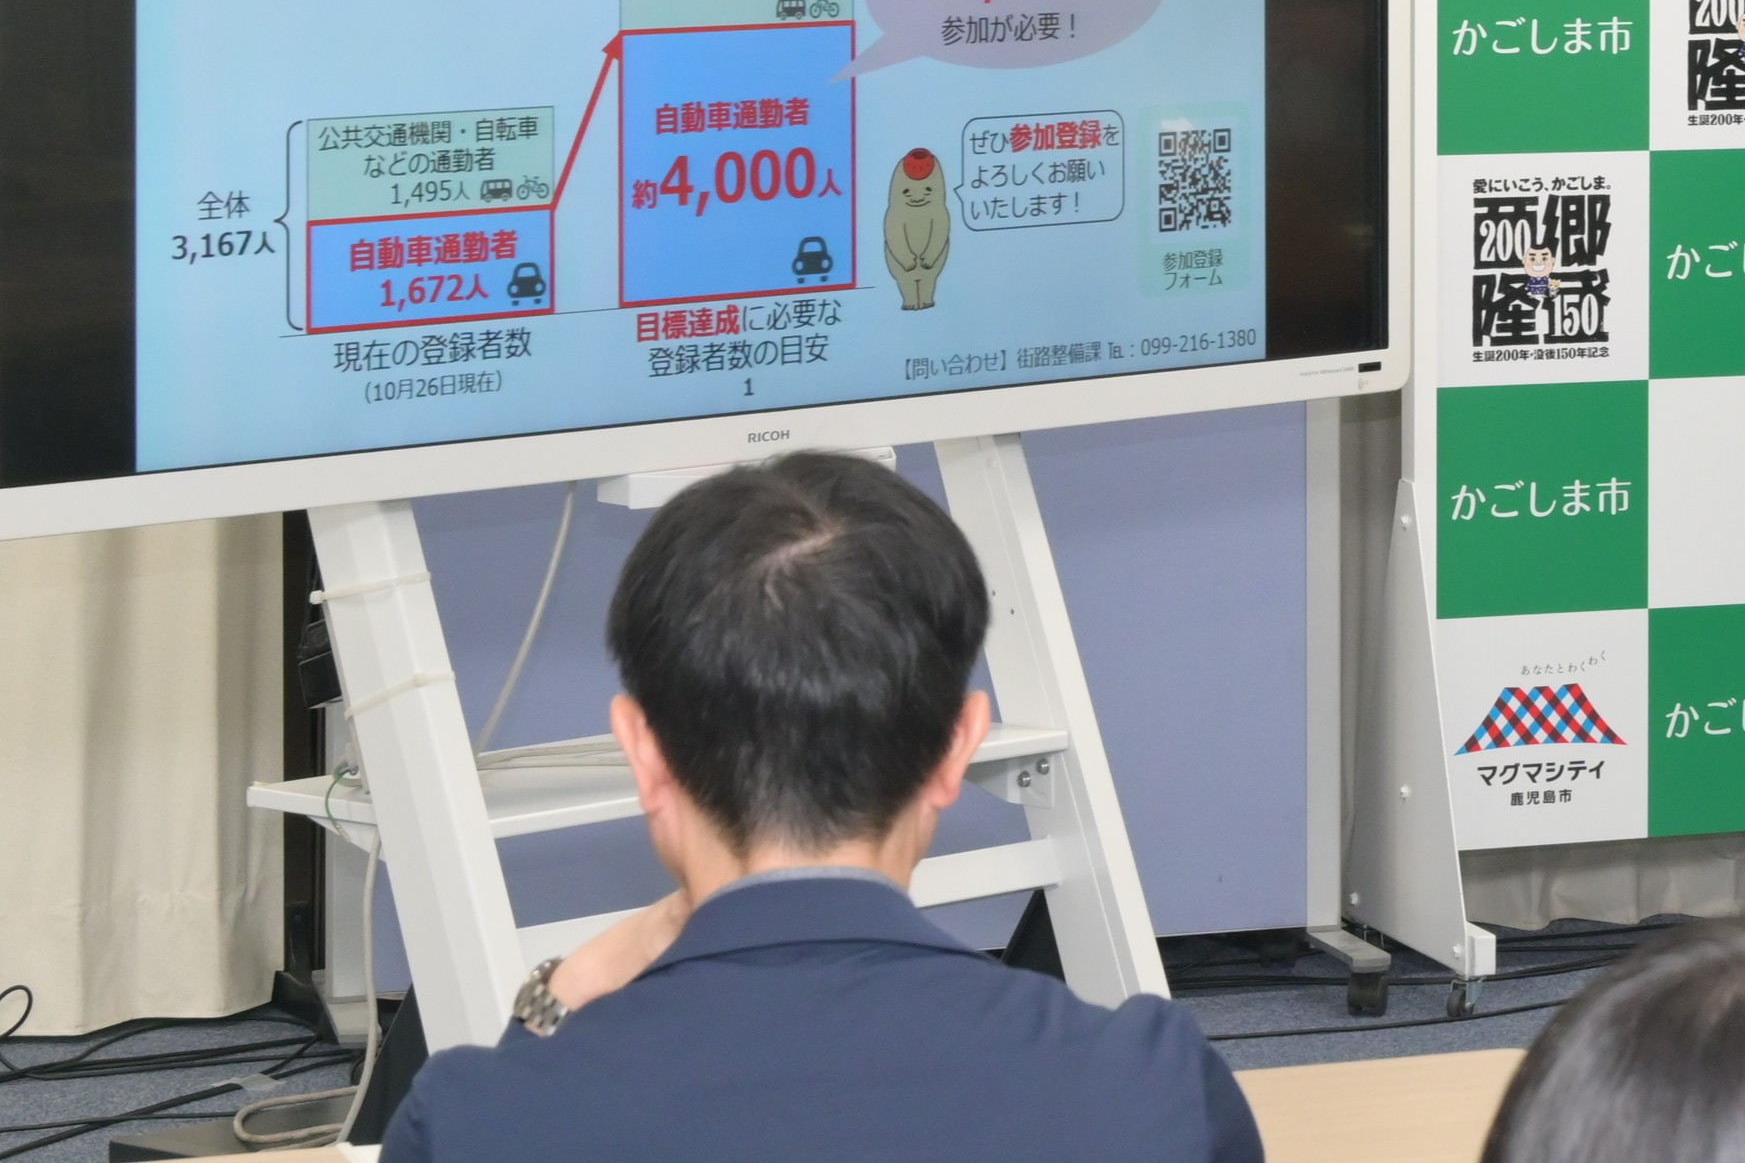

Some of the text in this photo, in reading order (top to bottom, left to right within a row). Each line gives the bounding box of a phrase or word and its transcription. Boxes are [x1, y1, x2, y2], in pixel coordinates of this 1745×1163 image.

[1453, 16, 1633, 56] かごしま市
[657, 98, 810, 134] 自動車通勤者
[970, 121, 1120, 154] ぜひ参加登録を
[363, 148, 496, 179] などの通勤者
[971, 159, 1105, 189] よろしくお願い
[392, 180, 470, 208] 1,495人
[633, 148, 841, 216] 約4,000人
[1473, 176, 1611, 193] 愛にいこう、かごしま。
[197, 191, 250, 220] 全体
[172, 231, 275, 264] 3,167人
[349, 230, 518, 271] 自動車通勤者
[1163, 249, 1223, 270] 参加登録
[380, 275, 490, 308] 1,672人
[1164, 270, 1223, 290] フォーム
[636, 299, 842, 343] 目標達成に必要な
[333, 328, 532, 372] 現在の登録者数
[648, 336, 829, 378] 登録者数の目安
[744, 378, 754, 396] 1
[748, 430, 789, 443] RICOH
[1451, 477, 1631, 520] かごしま市
[1519, 650, 1607, 675] あなたとわくわく
[1477, 761, 1605, 787] マグマシティ
[1511, 789, 1572, 806] 鹿児島市
